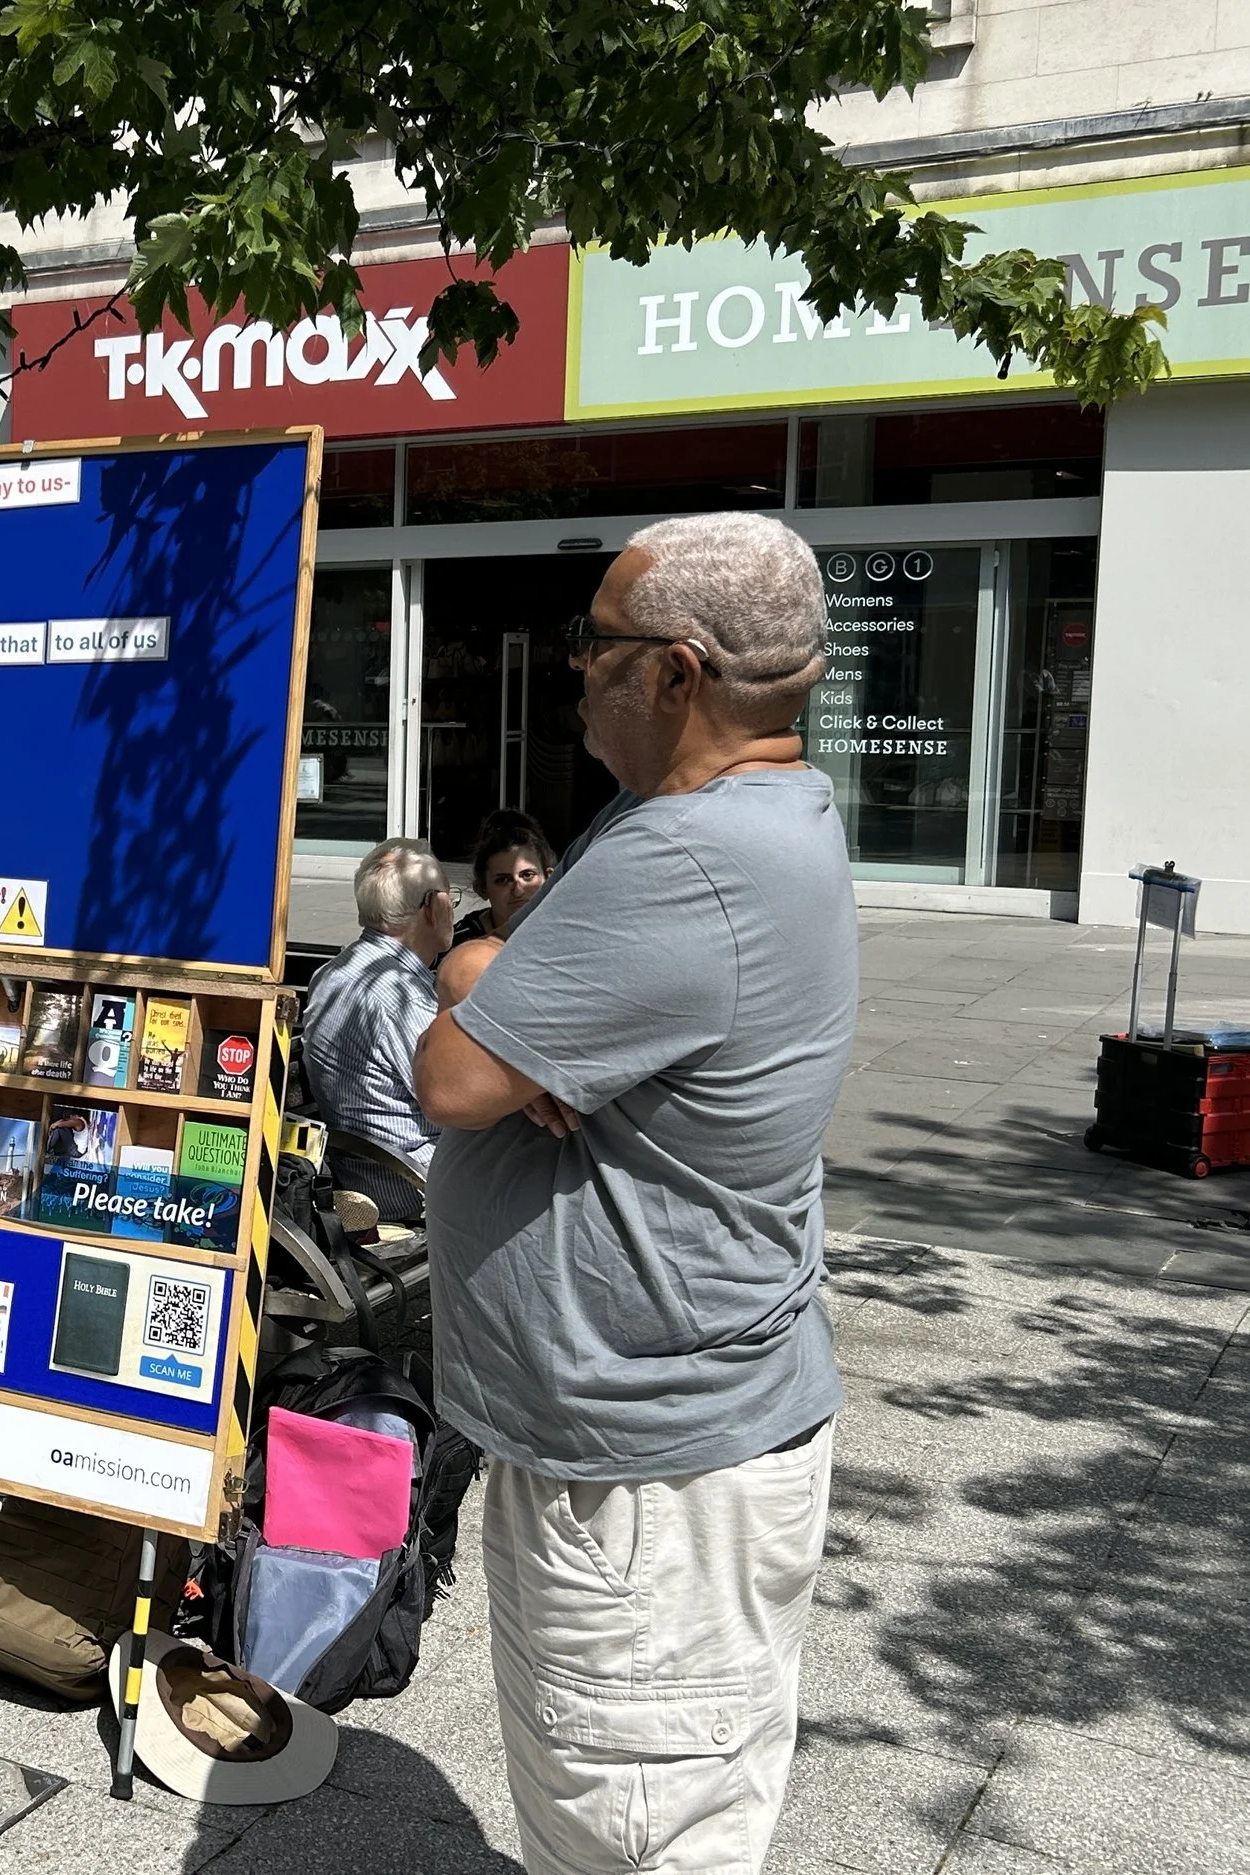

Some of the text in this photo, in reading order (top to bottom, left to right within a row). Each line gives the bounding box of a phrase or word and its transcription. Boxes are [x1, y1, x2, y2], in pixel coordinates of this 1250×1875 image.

[637, 236, 1250, 356] HOMNSE
[17, 478, 36, 495] to
[41, 477, 71, 491] us-
[835, 558, 921, 575] B G 1
[826, 594, 893, 607] Womens
[825, 618, 914, 633] Accessories
[0, 635, 38, 653] that
[55, 633, 74, 650] to
[80, 630, 102, 650] all
[109, 630, 129, 650] of
[133, 633, 157, 649] us
[823, 643, 869, 657] Shoes
[824, 667, 862, 681] Mens
[820, 691, 853, 705] Kids
[820, 715, 944, 730] Click & Collect
[818, 739, 947, 756] HOMESENSE
[221, 1047, 251, 1063] STOP
[60, 1060, 72, 1069] life
[46, 1069, 72, 1079] death?
[217, 1073, 236, 1083] WHO
[213, 1081, 250, 1092] YOU THINK
[226, 1091, 242, 1099] AM?
[198, 1131, 247, 1151] ULTIMATE
[188, 1144, 245, 1168] QUESTIONS
[63, 1168, 109, 1184] Suffering?
[151, 1165, 168, 1173] you
[132, 1183, 165, 1194] Jesus?
[72, 1182, 215, 1228] Please take!
[73, 1279, 118, 1298] HOLY BIBLE
[149, 1363, 192, 1382] SCAN ME
[50, 1448, 192, 1495] oamission.com
